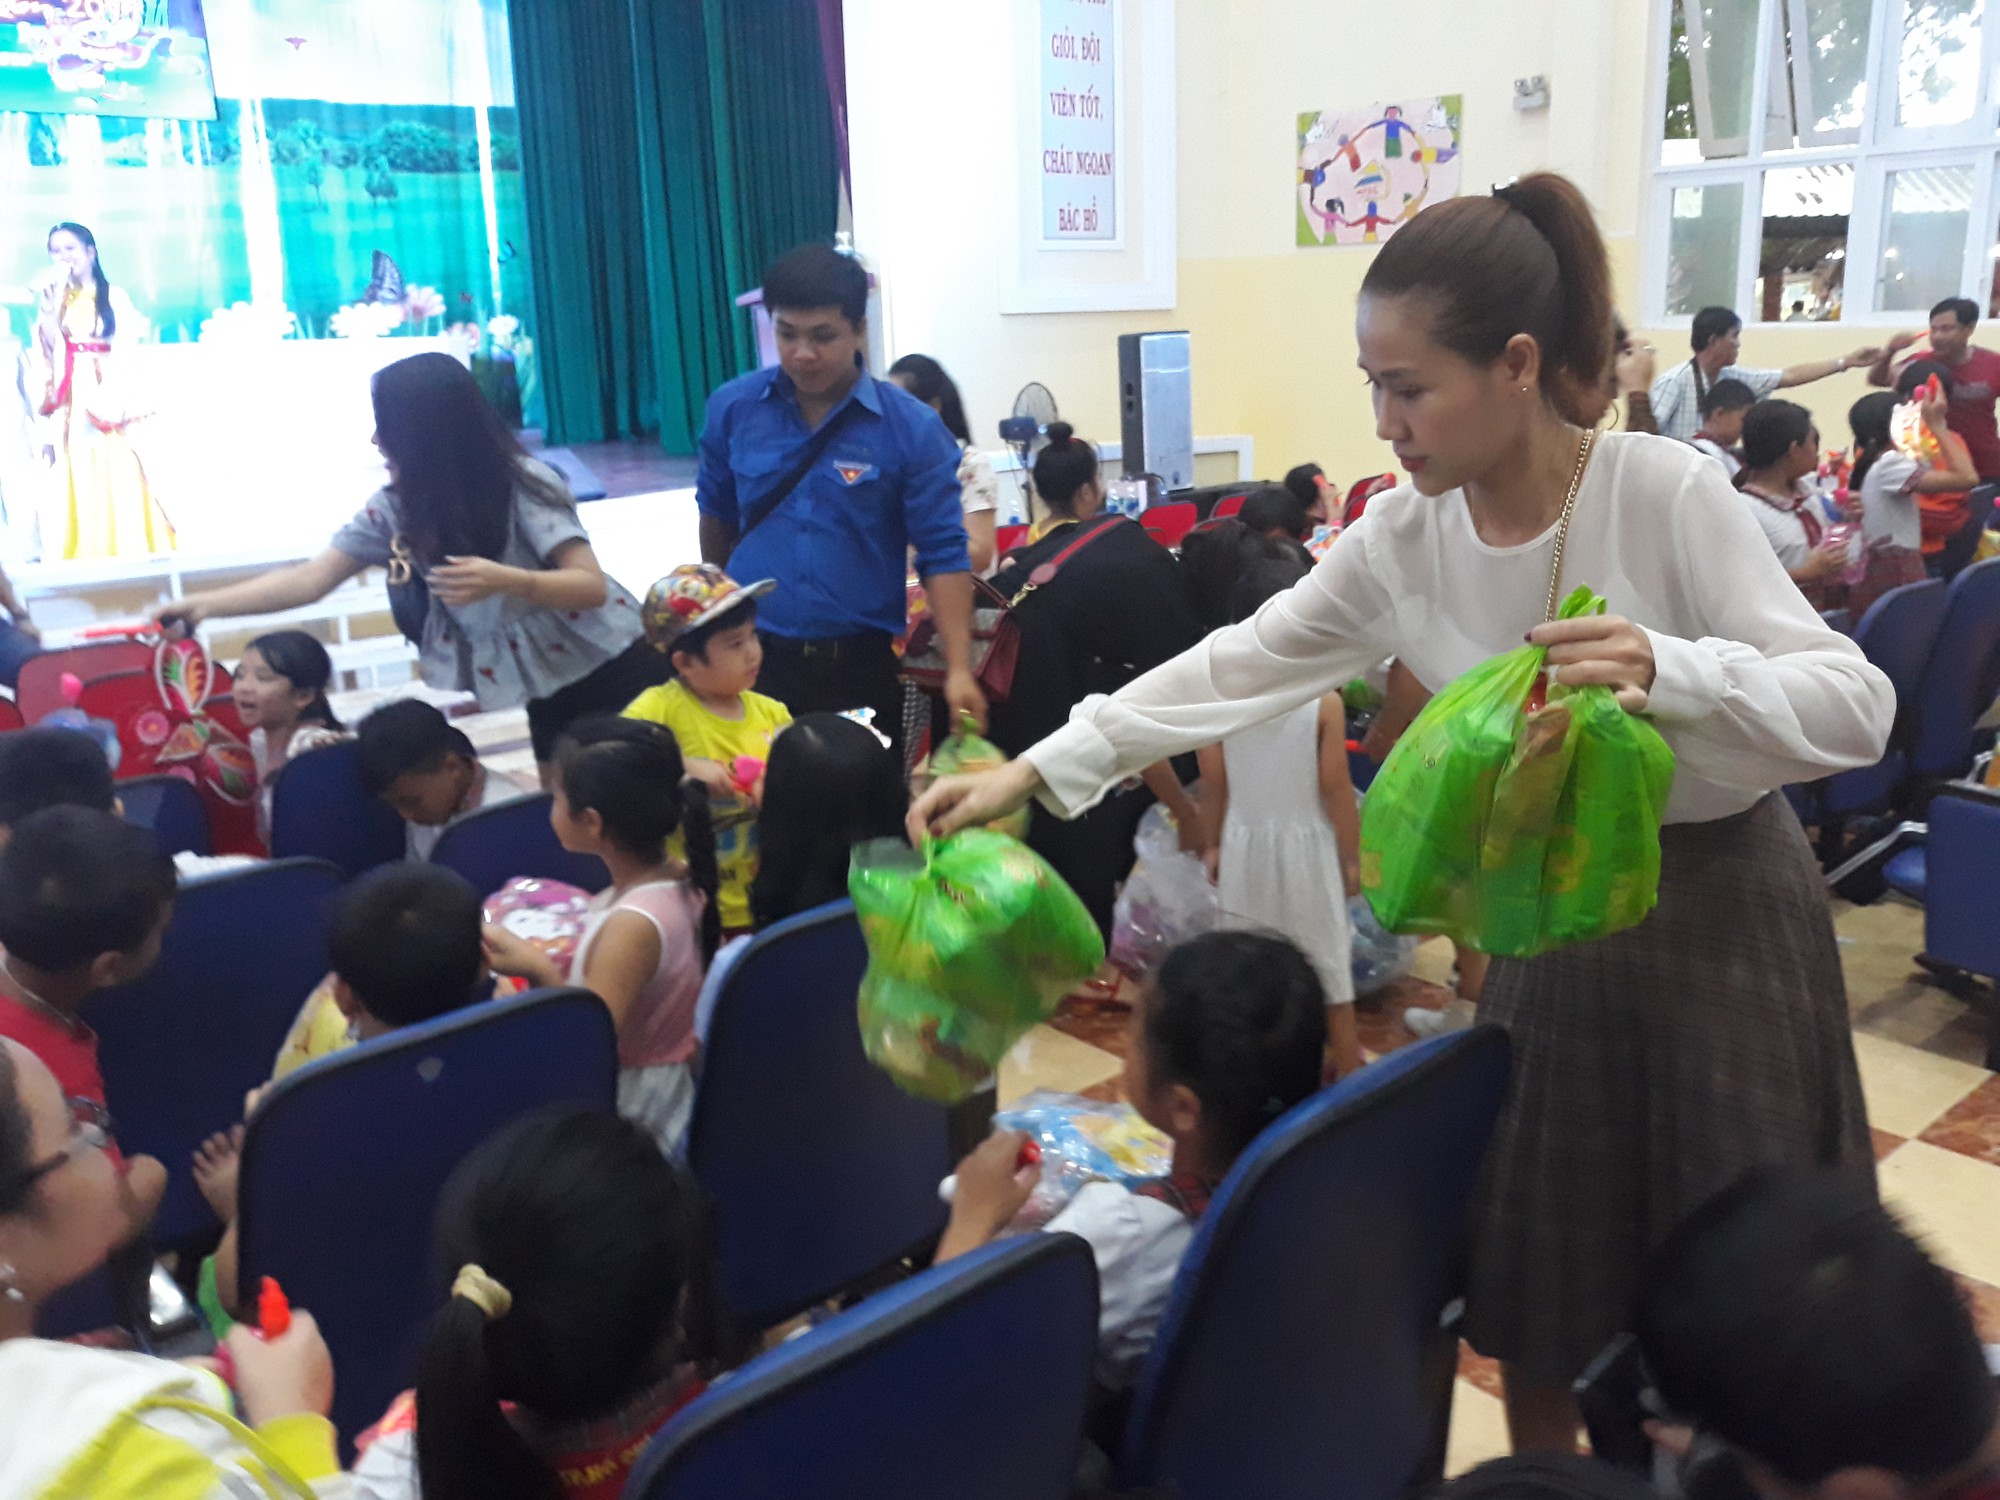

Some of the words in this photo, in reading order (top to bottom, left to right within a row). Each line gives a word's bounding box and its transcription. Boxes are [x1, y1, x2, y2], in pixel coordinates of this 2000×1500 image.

[1081, 31, 1101, 67] ĐỘI
[1050, 86, 1076, 117] VIÊN
[1079, 84, 1103, 121] TỐT,
[1043, 144, 1073, 174] CHÁU
[1076, 152, 1112, 176] NGOAN
[1058, 202, 1080, 232] BÁC
